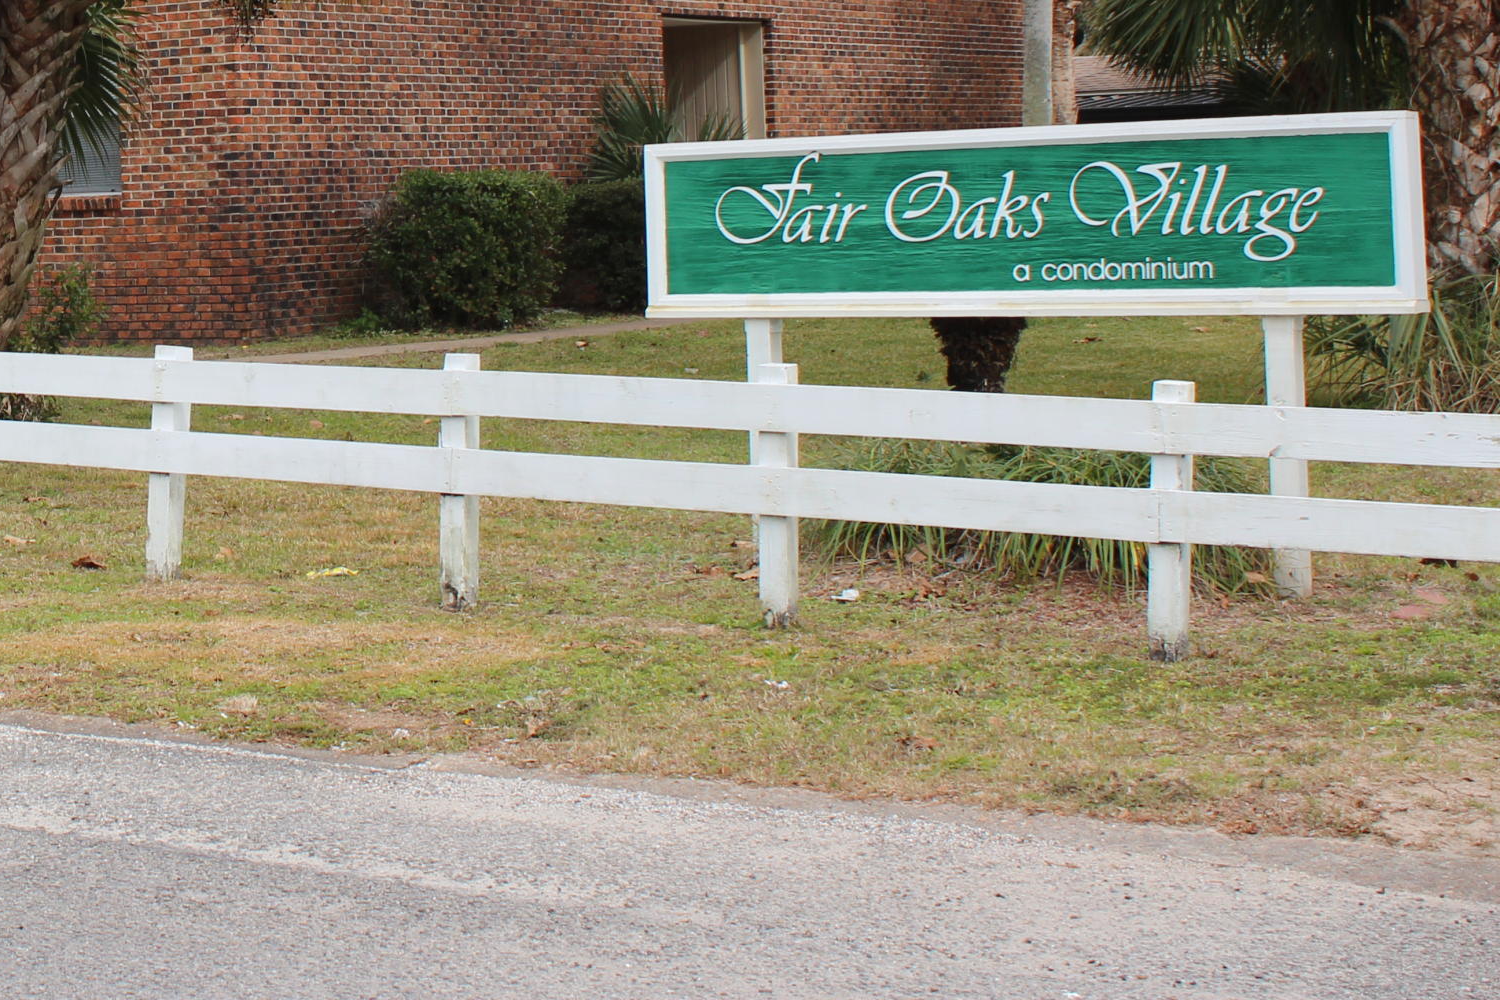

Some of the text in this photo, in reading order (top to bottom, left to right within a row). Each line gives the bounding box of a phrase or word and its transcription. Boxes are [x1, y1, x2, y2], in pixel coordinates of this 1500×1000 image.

[714, 150, 1325, 263] Fair Oaks Village
[1012, 257, 1215, 283] a condominium
